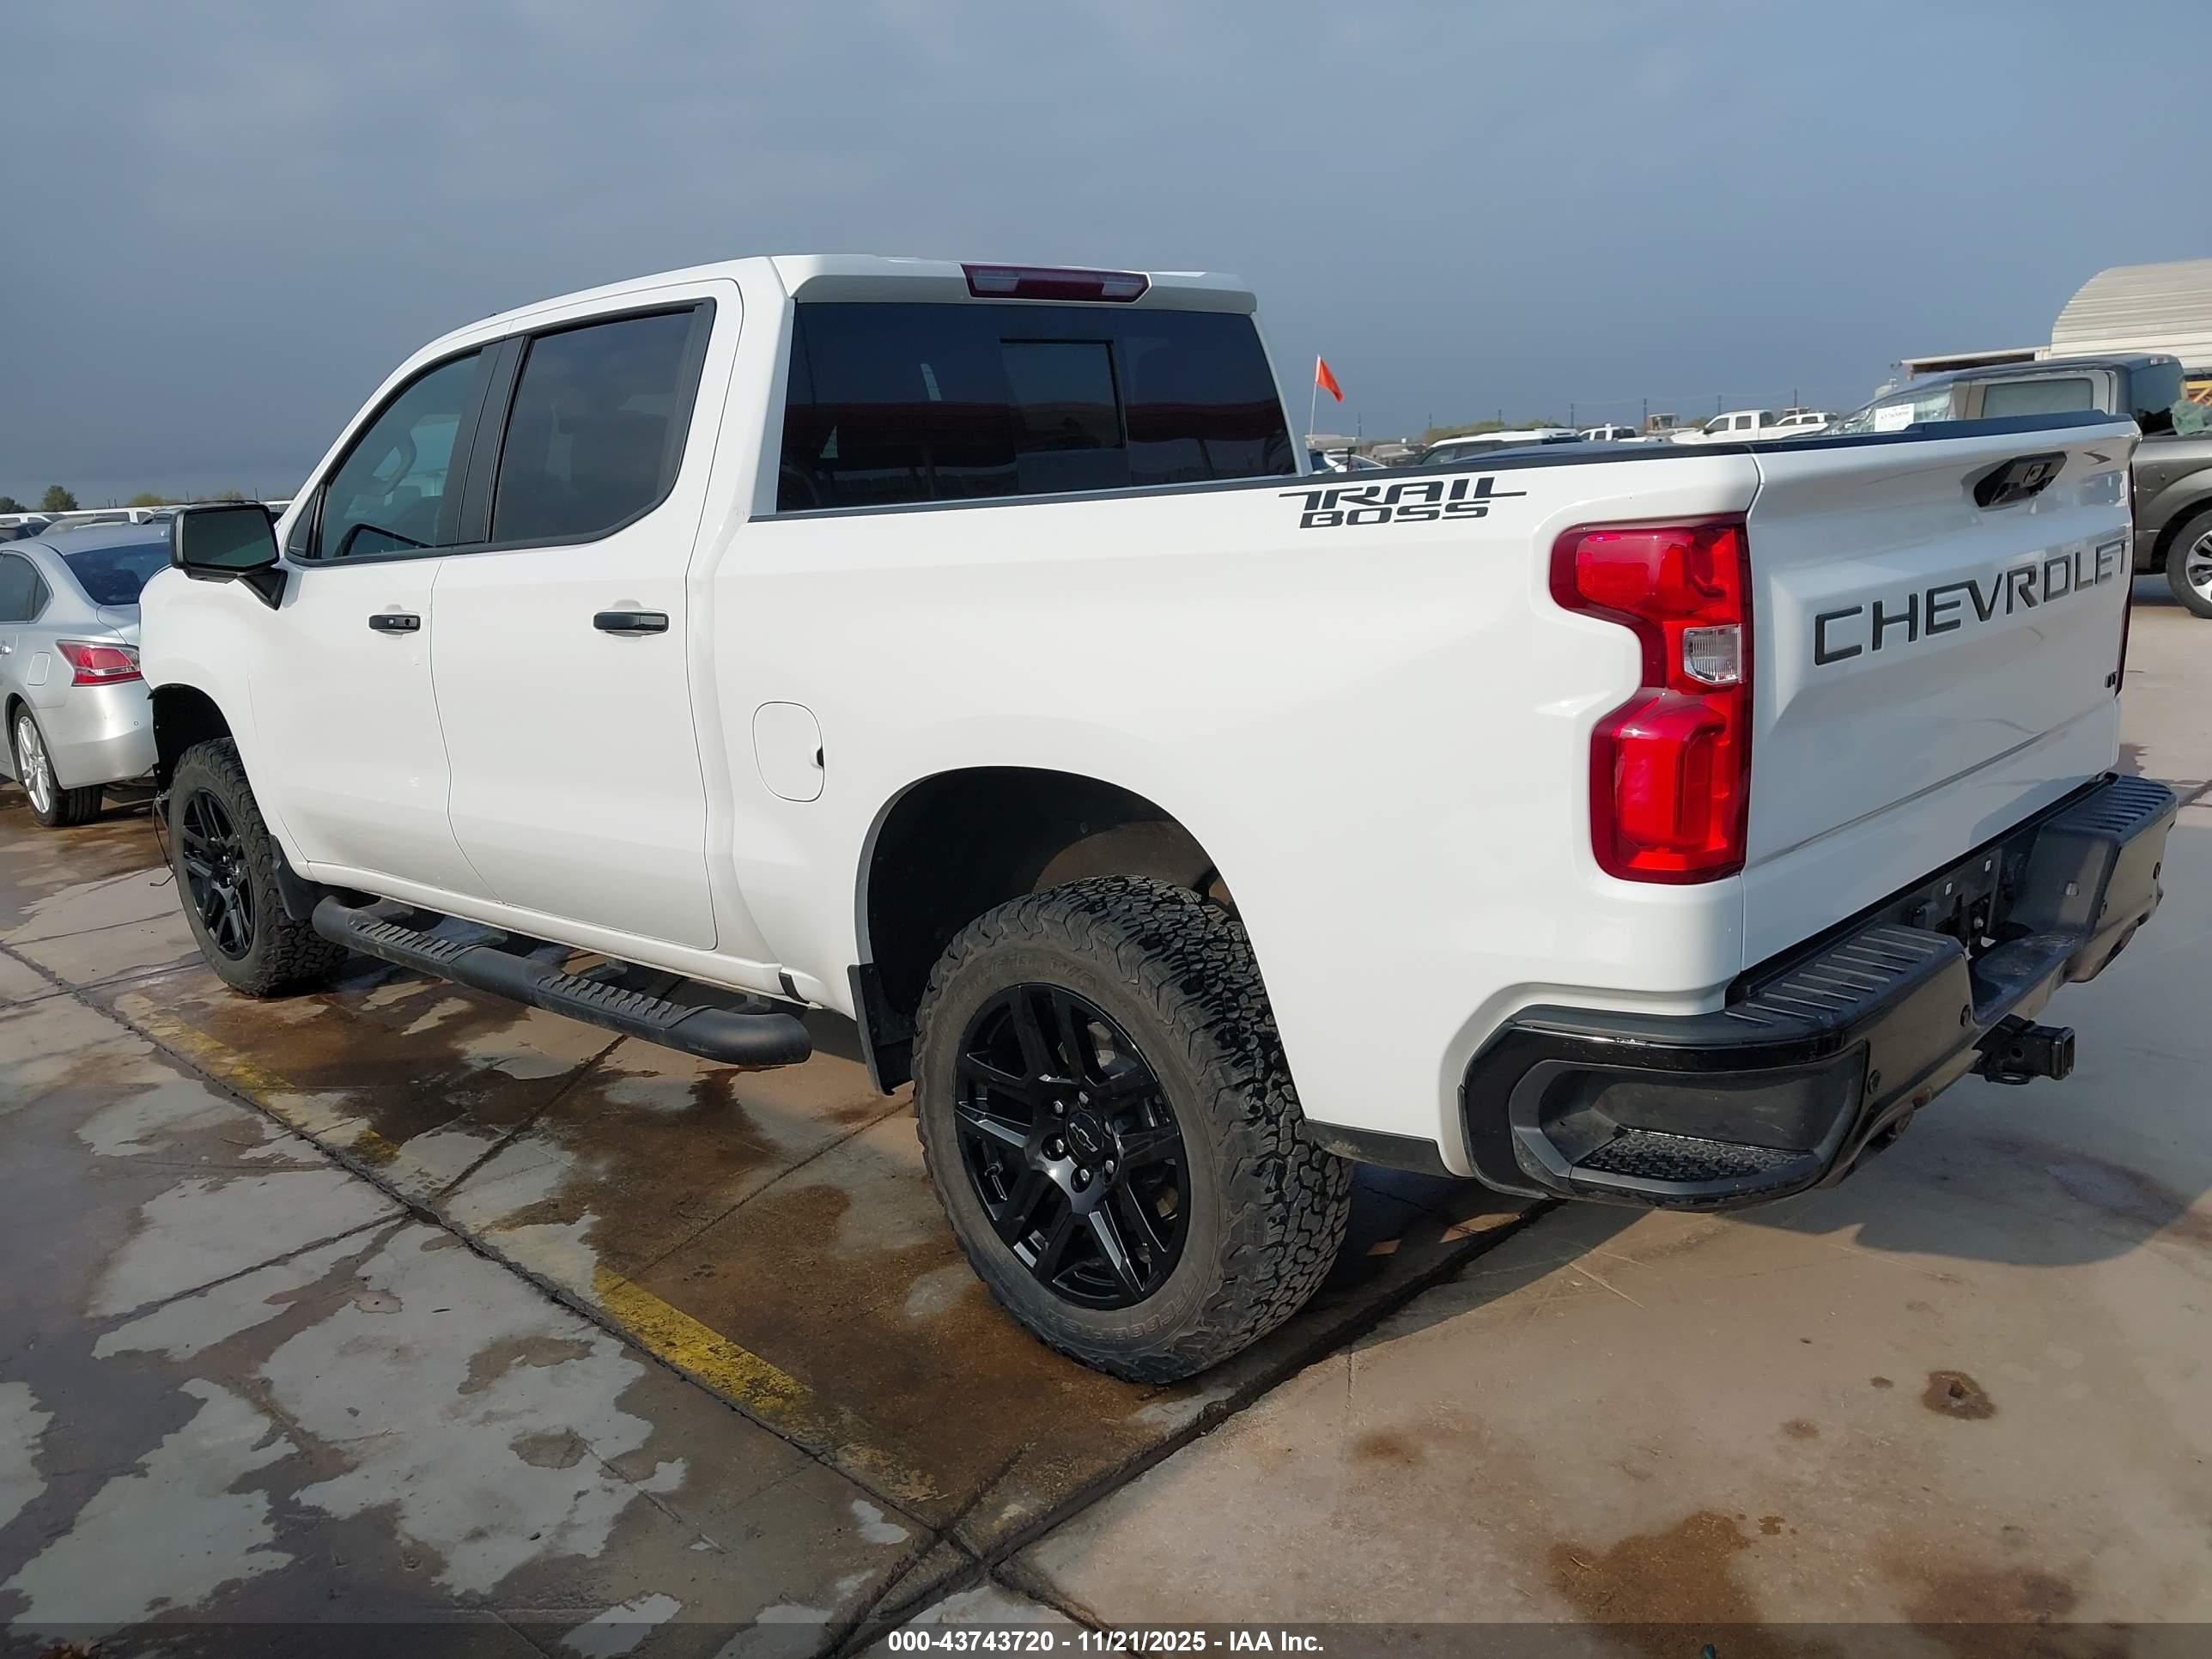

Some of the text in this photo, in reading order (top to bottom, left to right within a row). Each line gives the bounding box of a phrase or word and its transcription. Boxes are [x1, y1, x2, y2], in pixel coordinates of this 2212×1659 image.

[1279, 477, 1527, 511] TRAIL
[1299, 500, 1491, 528] BOSS
[1814, 536, 2130, 665] CHEVROLET
